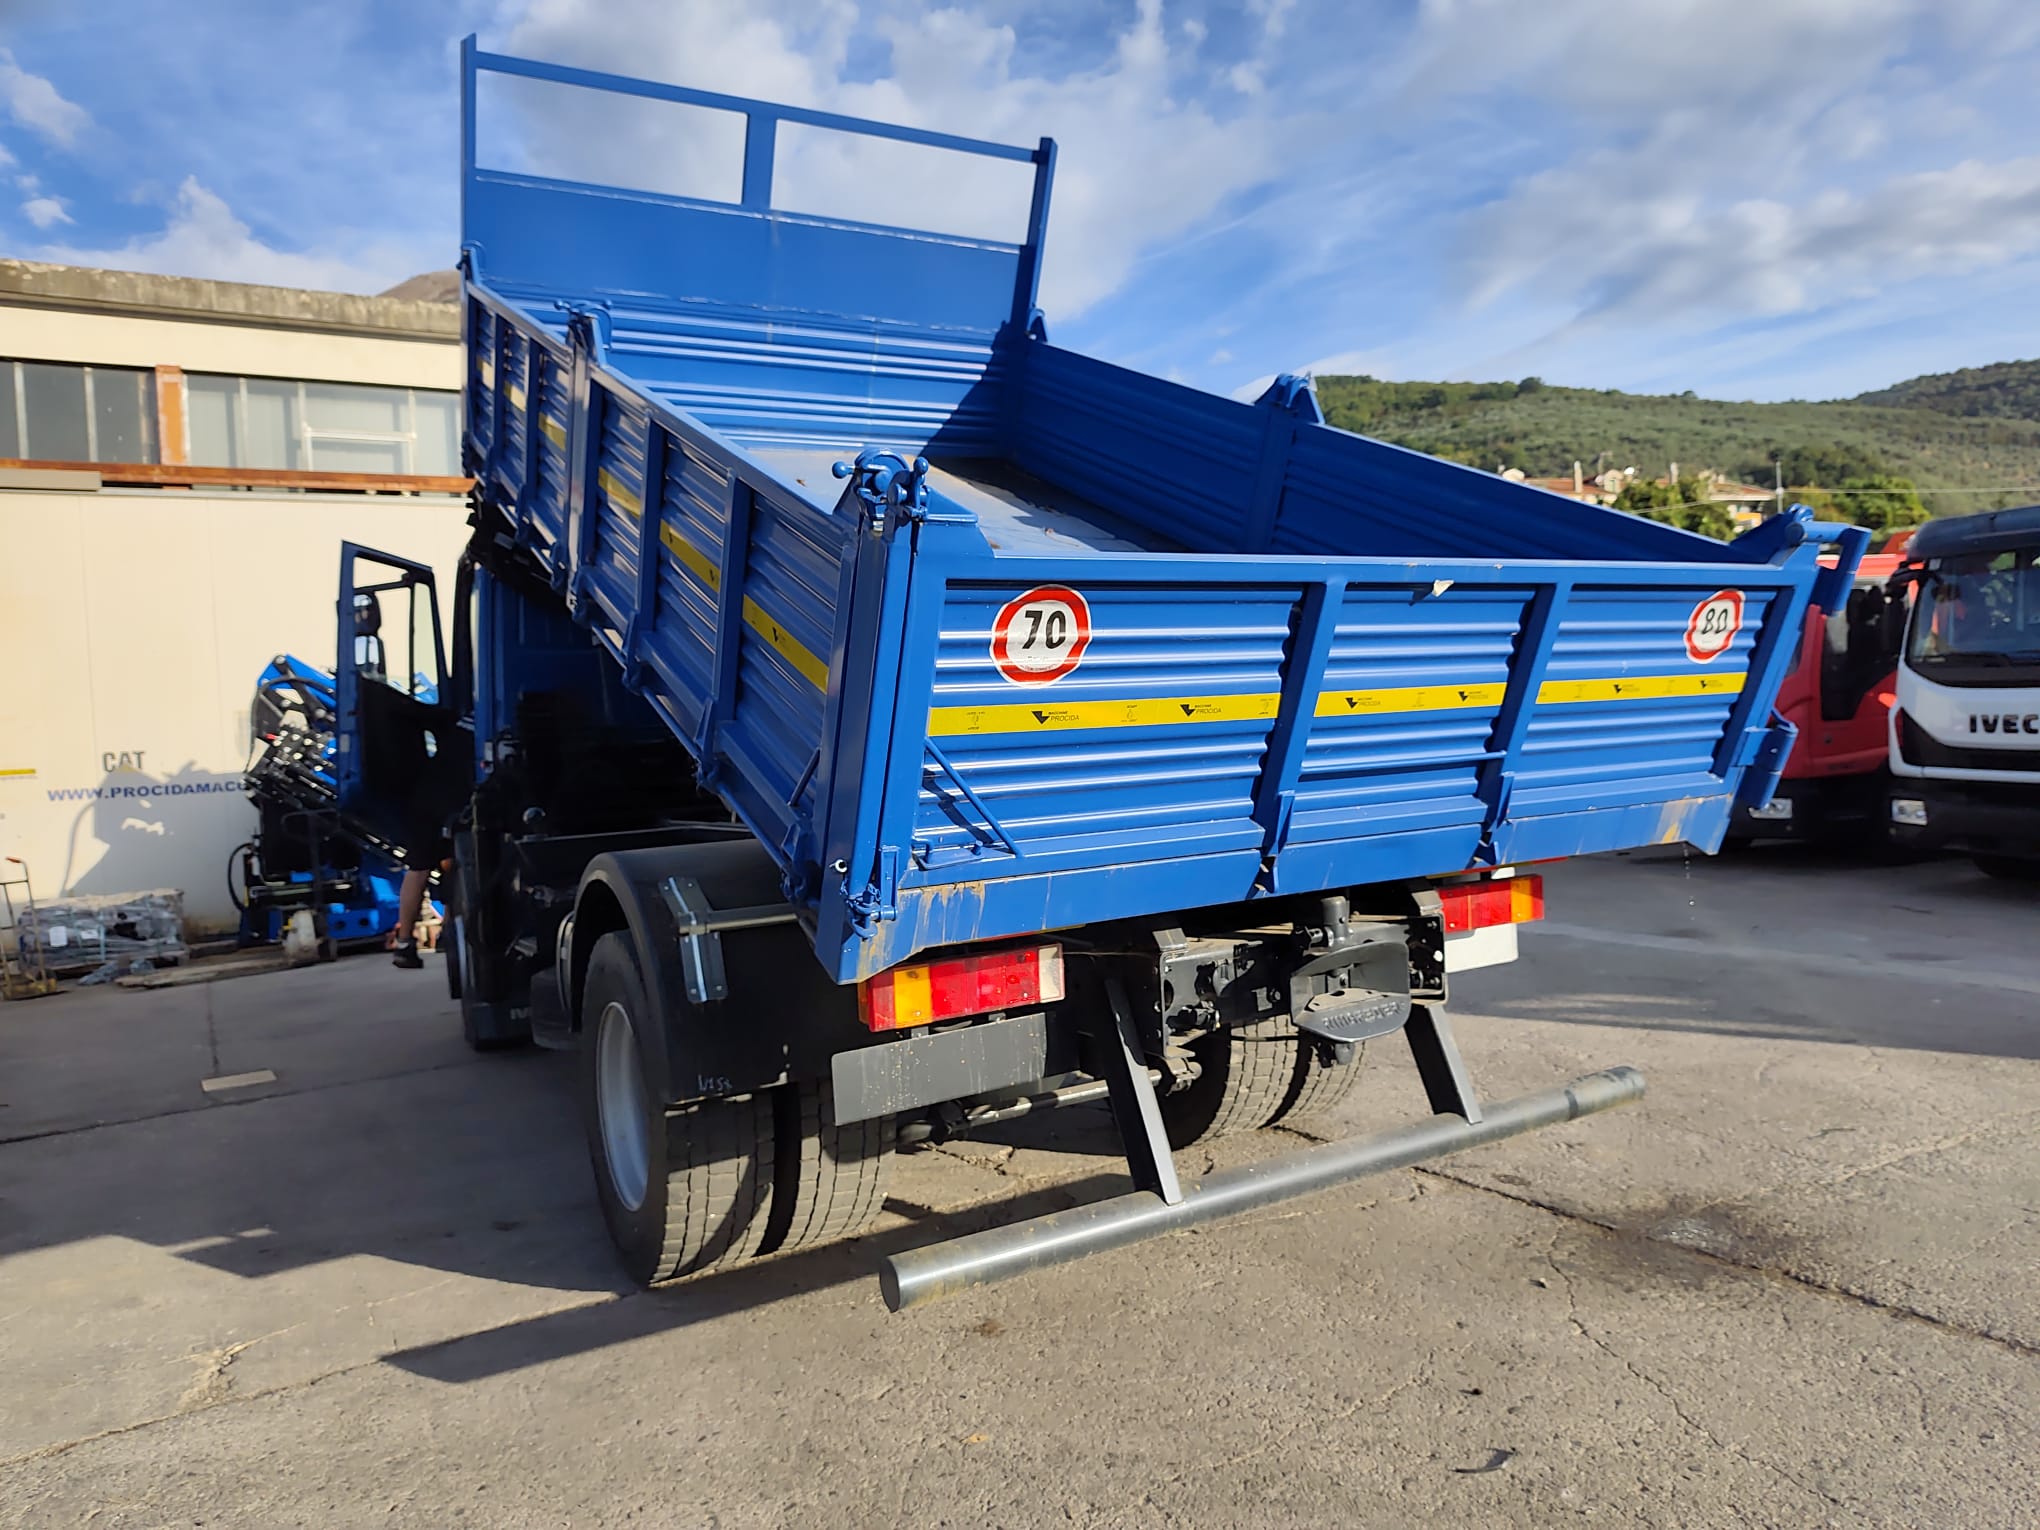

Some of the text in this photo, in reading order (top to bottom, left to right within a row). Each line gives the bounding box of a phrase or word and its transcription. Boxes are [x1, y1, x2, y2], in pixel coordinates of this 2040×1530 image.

[1022, 610, 1066, 650] 70
[1701, 608, 1728, 635] 80
[1969, 714, 2040, 735] IVEC
[103, 751, 145, 773] CAT
